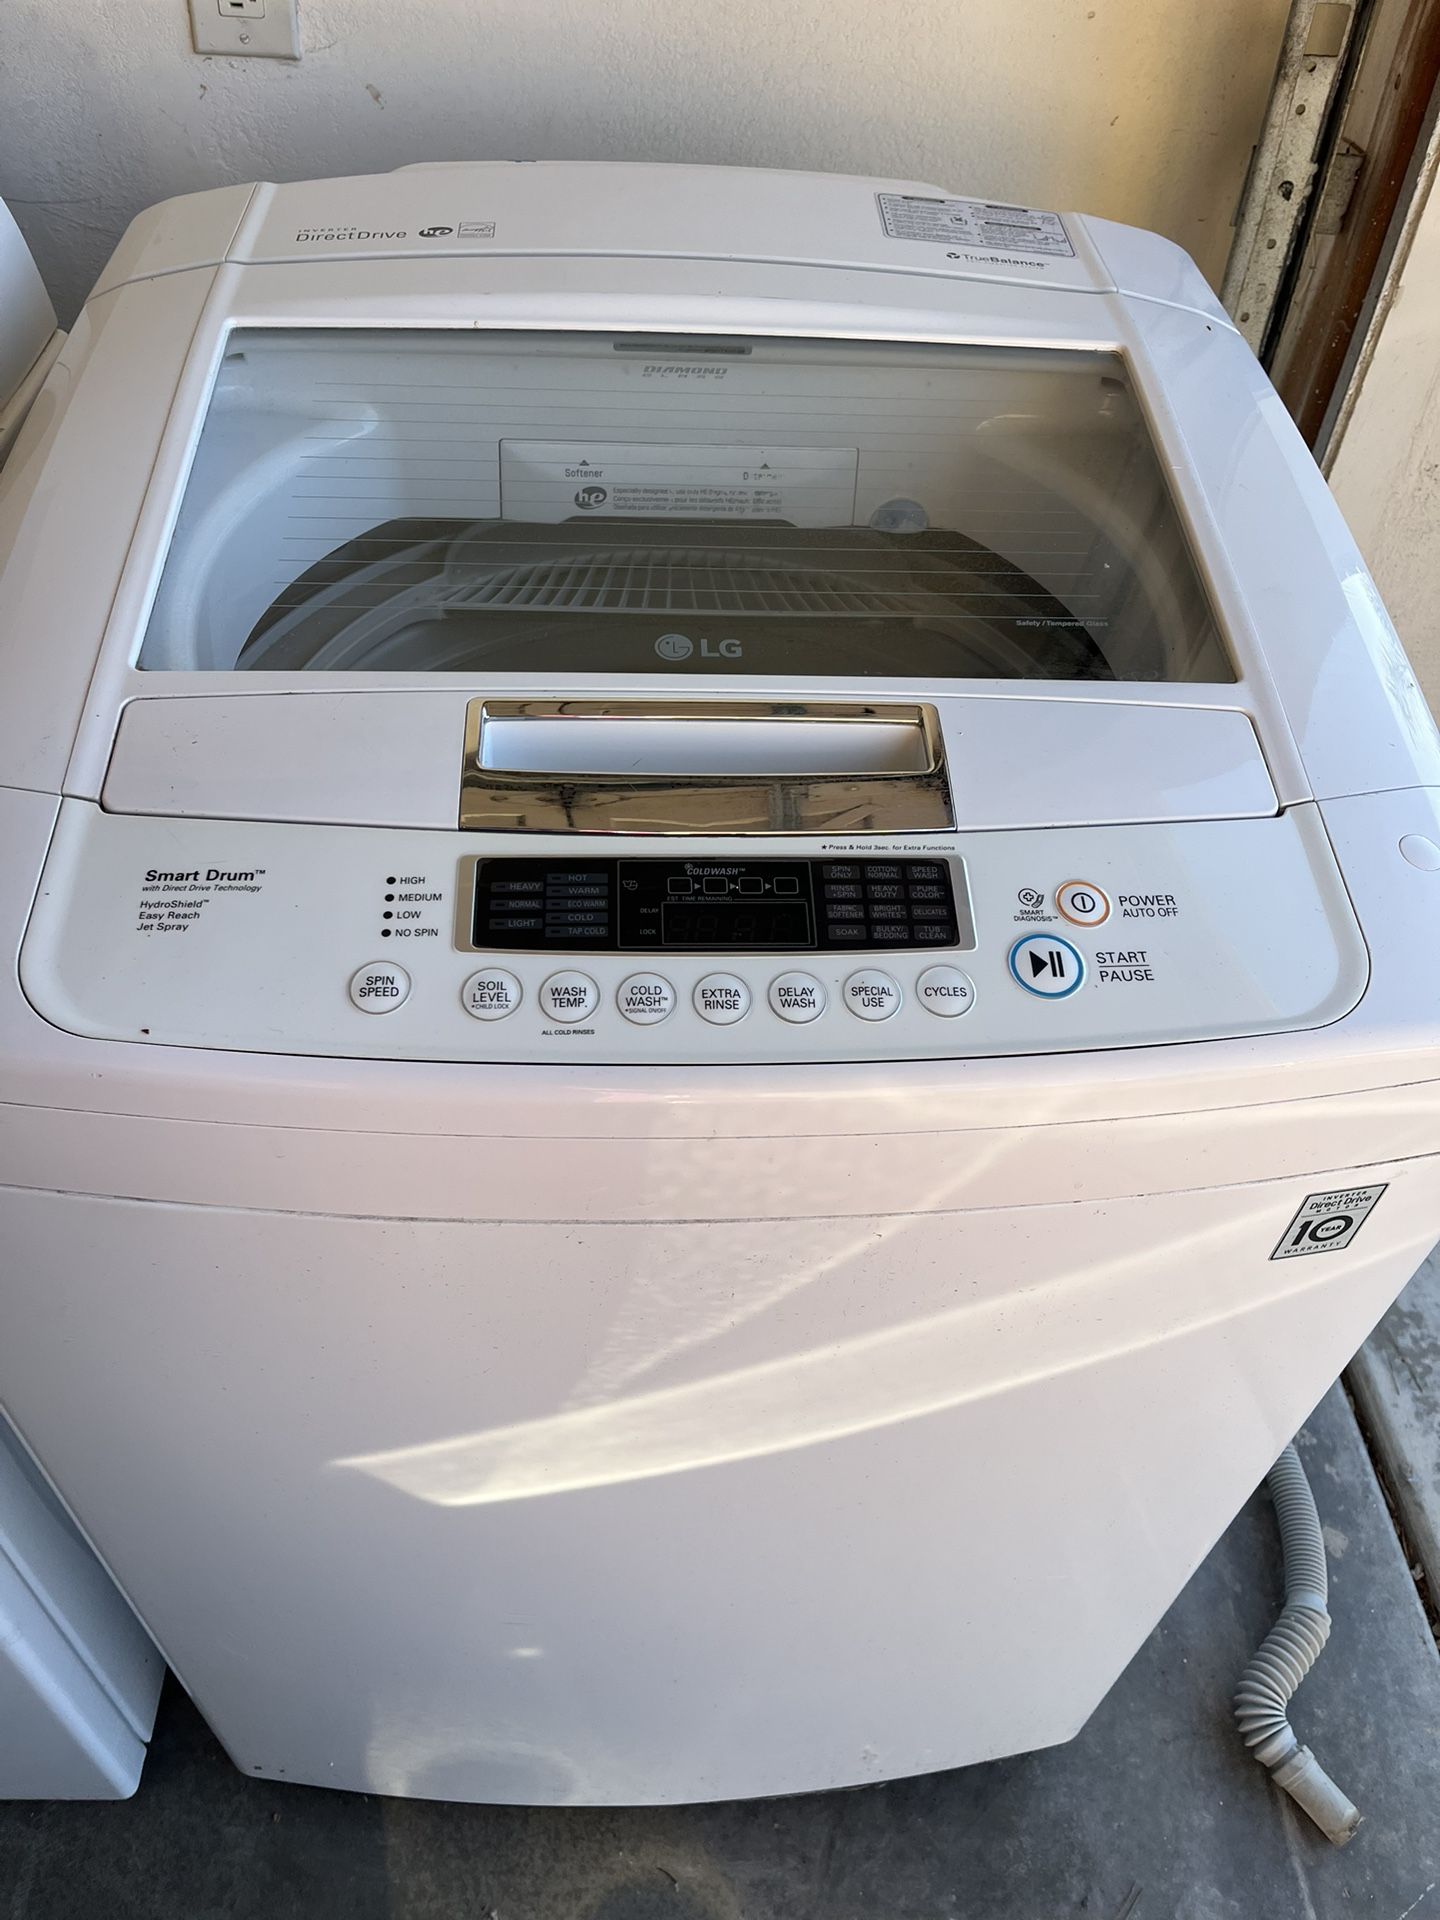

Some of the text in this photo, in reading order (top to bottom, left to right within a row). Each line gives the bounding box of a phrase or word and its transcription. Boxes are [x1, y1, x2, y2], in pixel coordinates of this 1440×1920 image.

[643, 365, 728, 375] DIAMOND
[565, 468, 603, 478] Softener
[700, 639, 743, 658] LG
[144, 869, 200, 882] Smart
[399, 876, 425, 885] HIGH
[142, 884, 262, 893] with Direct Drive Technology
[398, 893, 442, 902] MEDIUM
[1118, 895, 1177, 907] POWER
[509, 900, 541, 908] NORMAL
[138, 911, 200, 921] Easy Reach
[396, 911, 422, 919] LOW
[828, 911, 865, 919] SOFTENER
[1122, 907, 1179, 918] AUTO OFF
[136, 922, 189, 932] Jet Spray
[508, 920, 536, 928] LIGHT
[395, 928, 439, 937] NO SPIN
[568, 927, 606, 935] TAP COLD
[836, 928, 859, 936] SOAK
[1095, 951, 1148, 964] START
[366, 976, 395, 986] SPIN
[1099, 969, 1155, 982] PAUSE
[359, 986, 400, 998] SPEED
[477, 981, 507, 992] SOIL
[550, 986, 587, 997] WASH
[630, 985, 663, 996] COLD
[851, 986, 894, 997] SPECIAL
[924, 986, 968, 998] CYCLES
[472, 992, 512, 1003] LEVEL
[701, 988, 742, 999] EXTRA
[778, 987, 815, 998] DELAY
[704, 999, 740, 1010] RINSE
[780, 998, 816, 1008] WASH
[862, 997, 885, 1008] USE
[1322, 1190, 1368, 1201] INVERTER
[1315, 1203, 1360, 1213] MOTOR
[1290, 1215, 1354, 1247] 10
[1320, 1225, 1342, 1233] YEAR
[1283, 1240, 1342, 1255] WARRANTY
